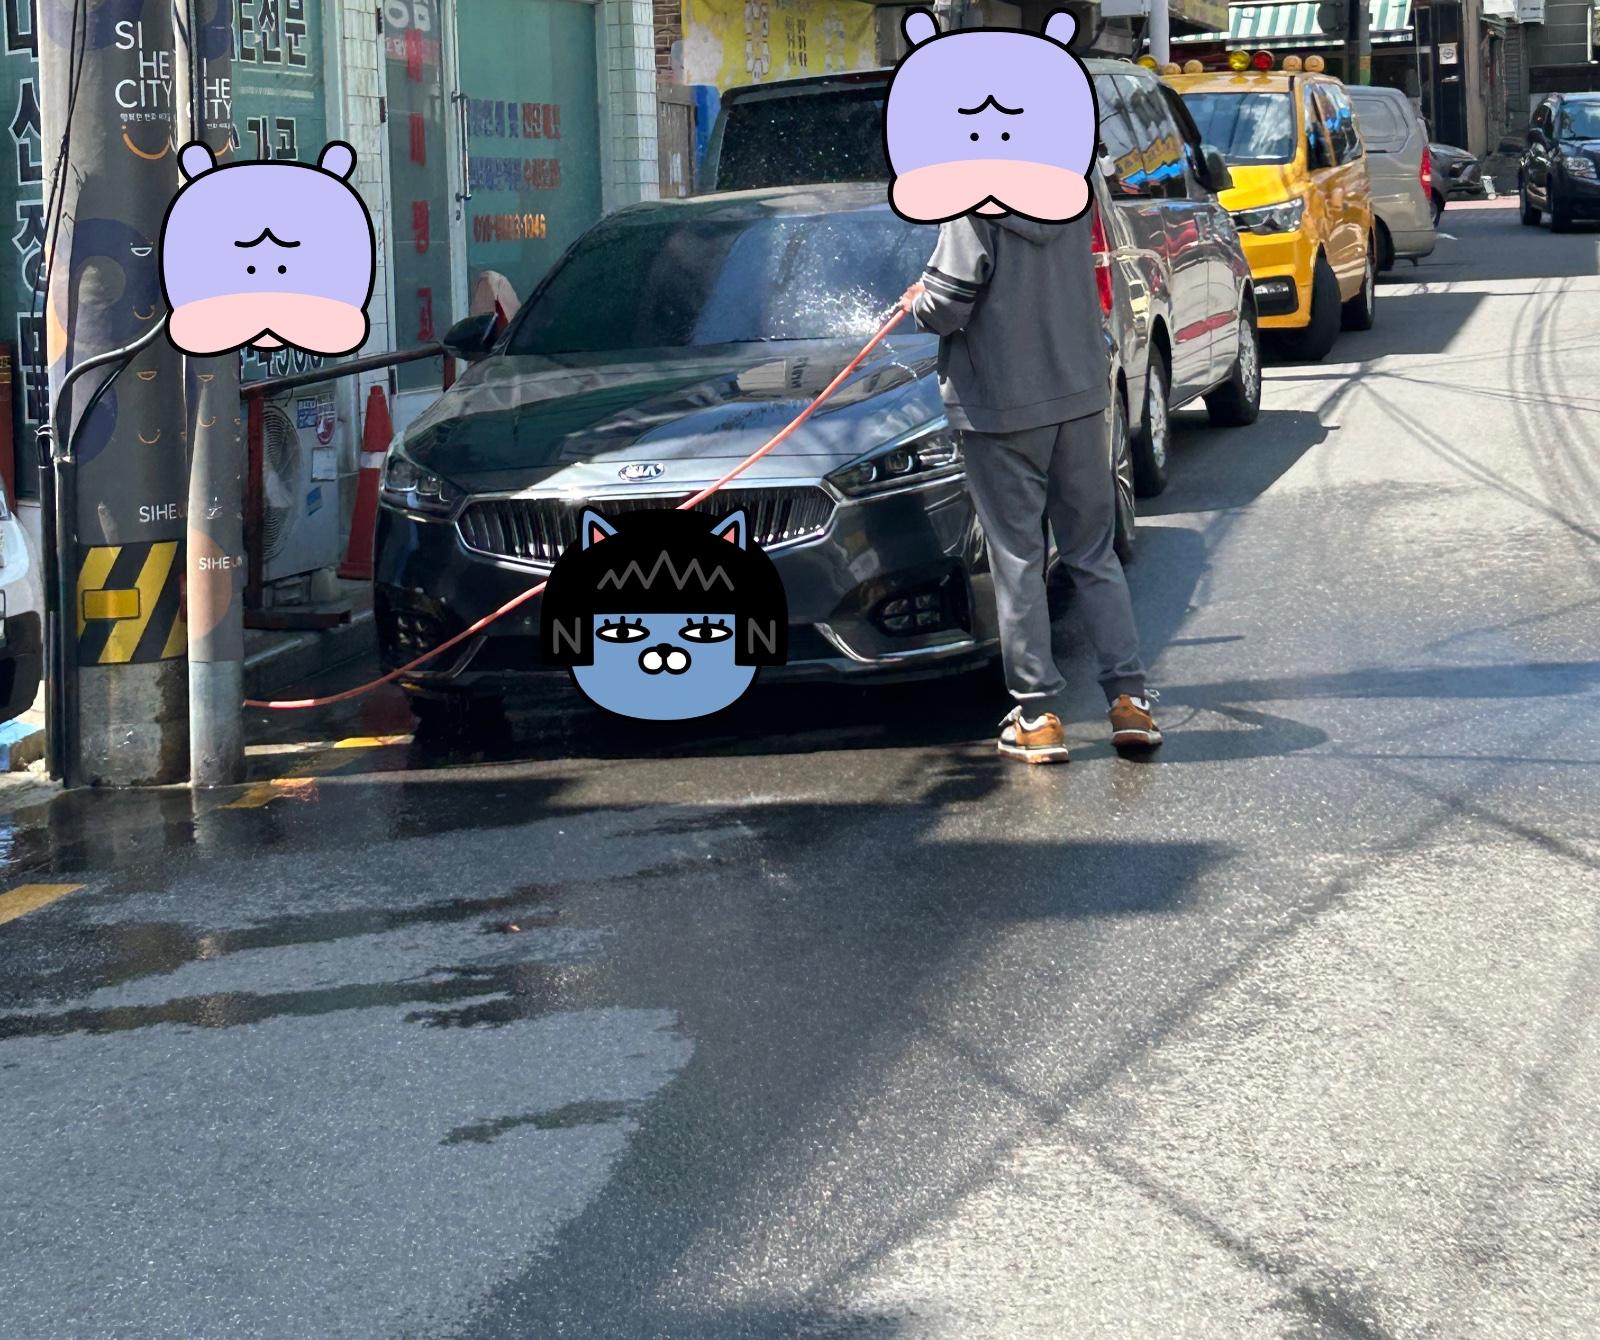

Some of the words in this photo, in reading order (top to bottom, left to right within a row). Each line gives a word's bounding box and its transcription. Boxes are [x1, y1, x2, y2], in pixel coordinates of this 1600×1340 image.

[115, 21, 143, 50] SI
[139, 50, 176, 79] HE
[115, 79, 173, 108] CITY
[203, 99, 232, 120] ITY
